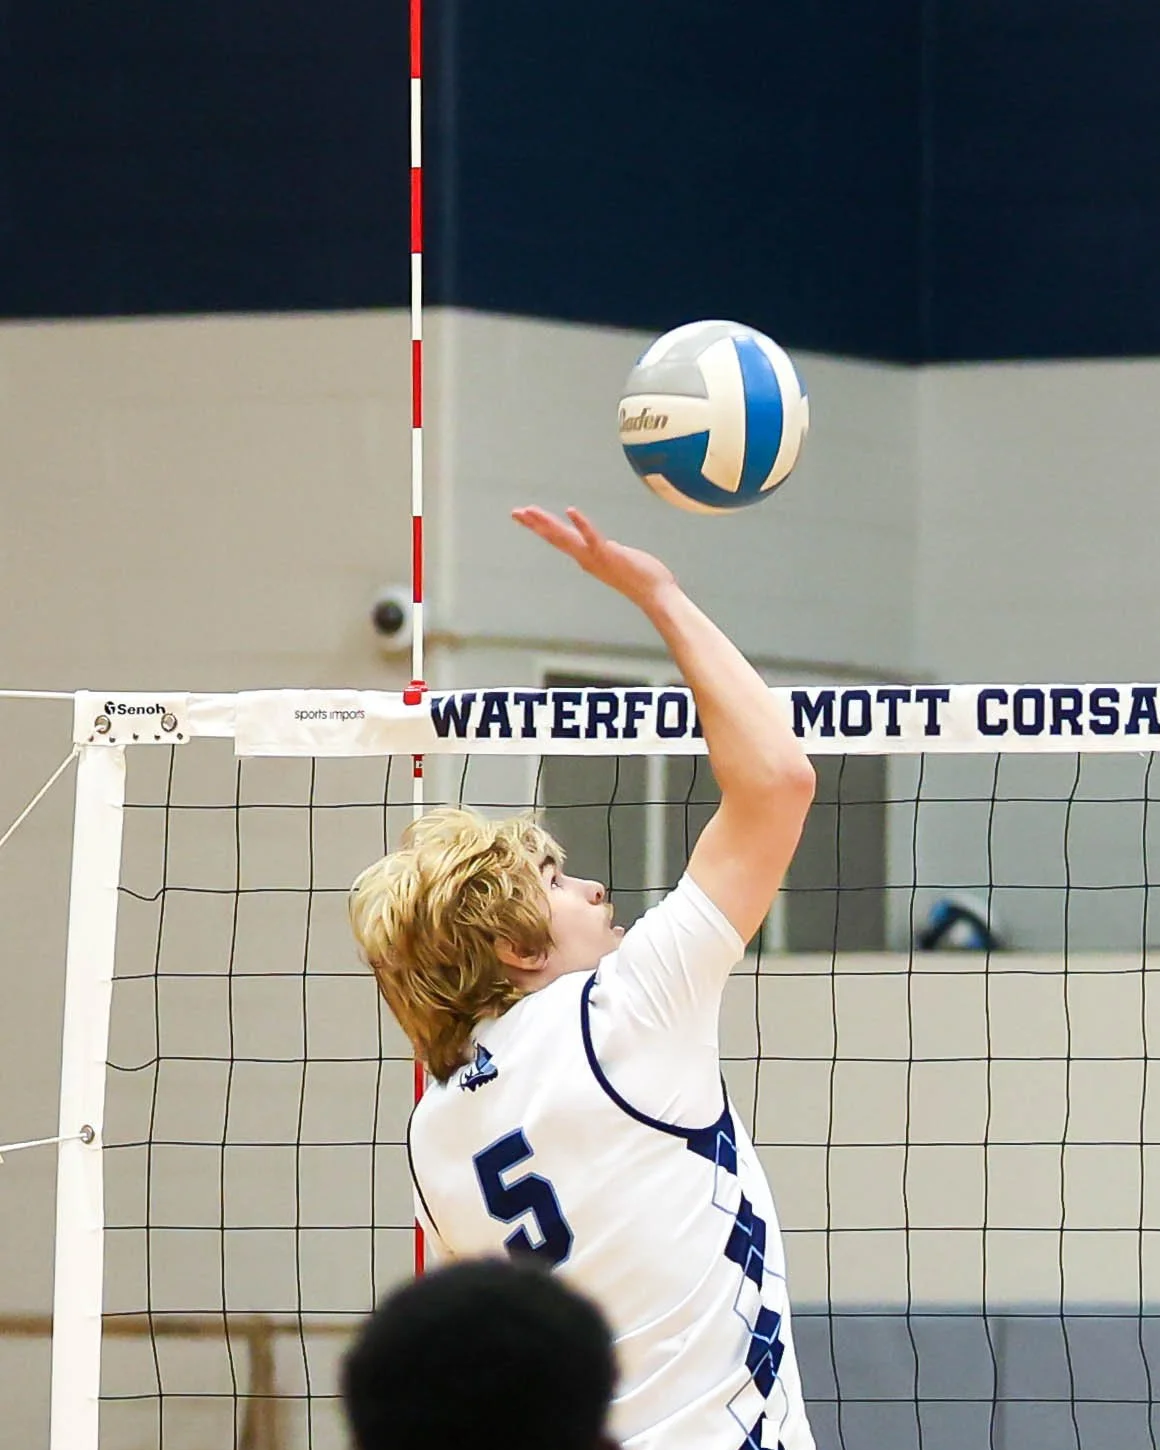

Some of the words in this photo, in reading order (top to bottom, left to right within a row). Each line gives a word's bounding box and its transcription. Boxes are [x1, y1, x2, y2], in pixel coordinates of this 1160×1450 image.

[117, 703, 166, 715] Senoh
[294, 709, 328, 720] sports
[431, 691, 703, 738] WATERFO
[791, 688, 950, 738] MOTT
[472, 1126, 575, 1270] 5
